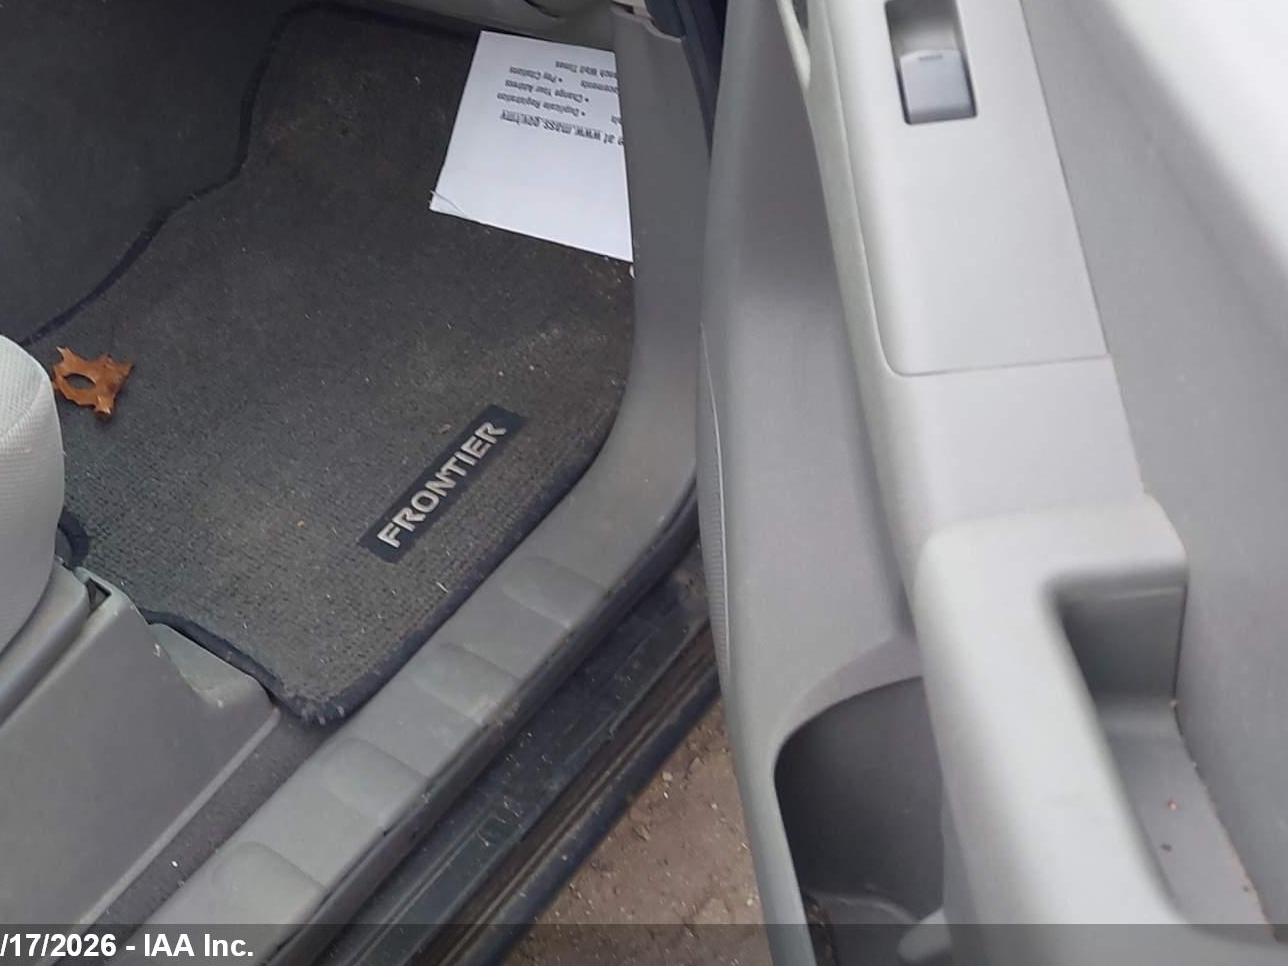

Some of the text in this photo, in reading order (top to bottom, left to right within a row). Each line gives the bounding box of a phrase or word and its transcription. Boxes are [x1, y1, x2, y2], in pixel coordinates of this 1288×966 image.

[509, 66, 557, 84] Pay Citations
[555, 60, 578, 74] Times
[505, 79, 583, 103] Change Your Address
[497, 92, 579, 117] Duplicate Registration
[377, 422, 507, 548] FRONTIER
